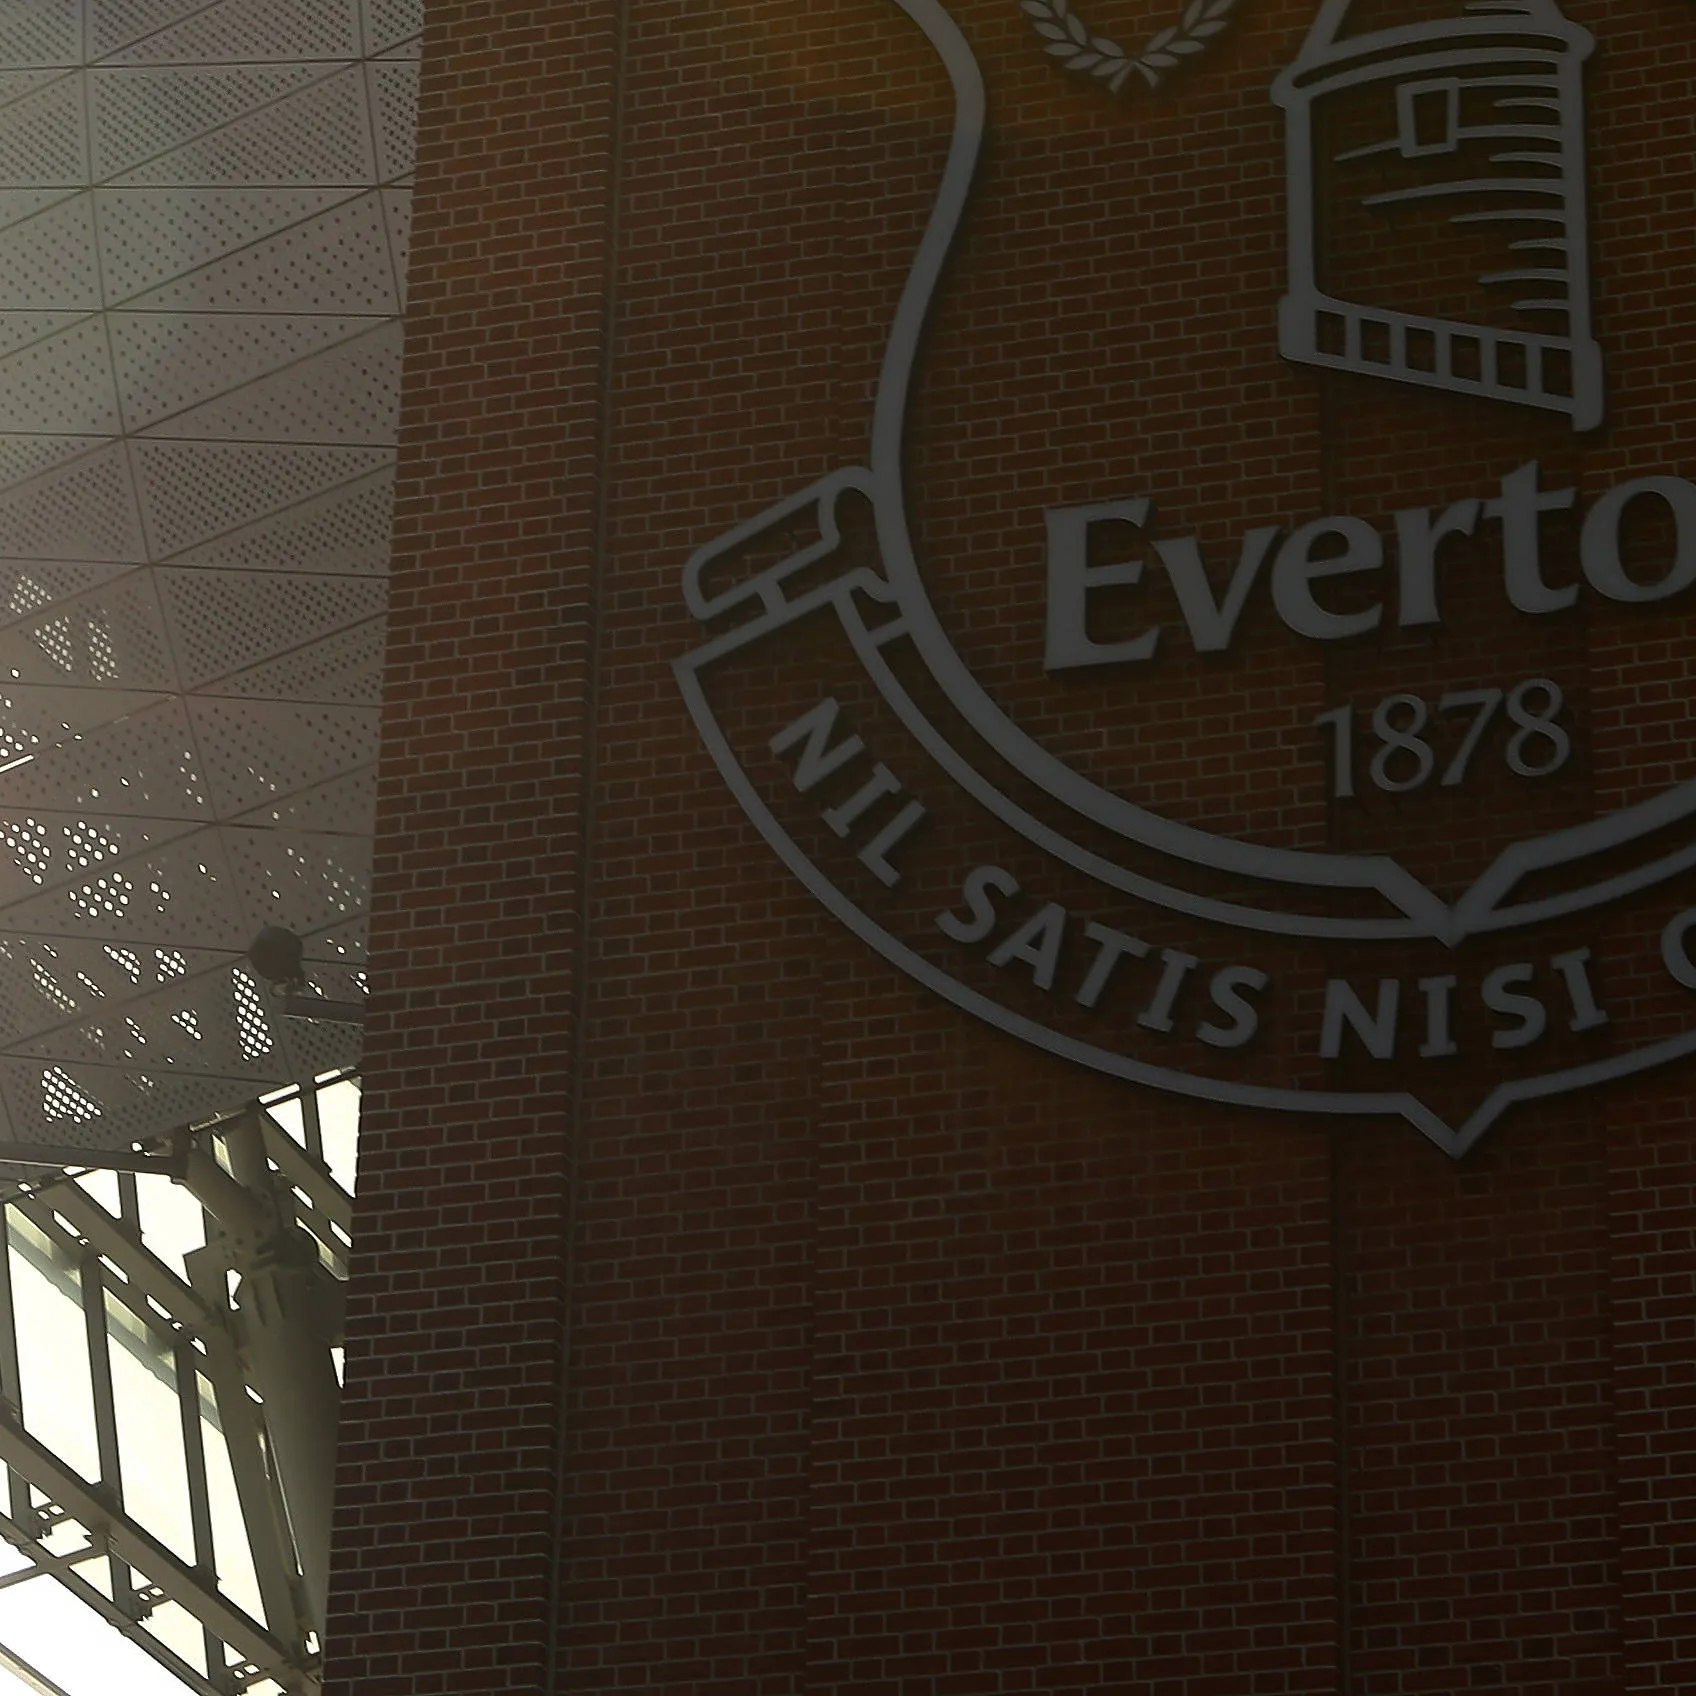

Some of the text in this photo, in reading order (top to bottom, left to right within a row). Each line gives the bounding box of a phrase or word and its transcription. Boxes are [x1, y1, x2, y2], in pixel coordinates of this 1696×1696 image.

[1314, 678, 1570, 800] 1878
[771, 698, 928, 888] NIL
[938, 866, 1270, 1051] SATIS
[1320, 947, 1607, 1060] NISI
